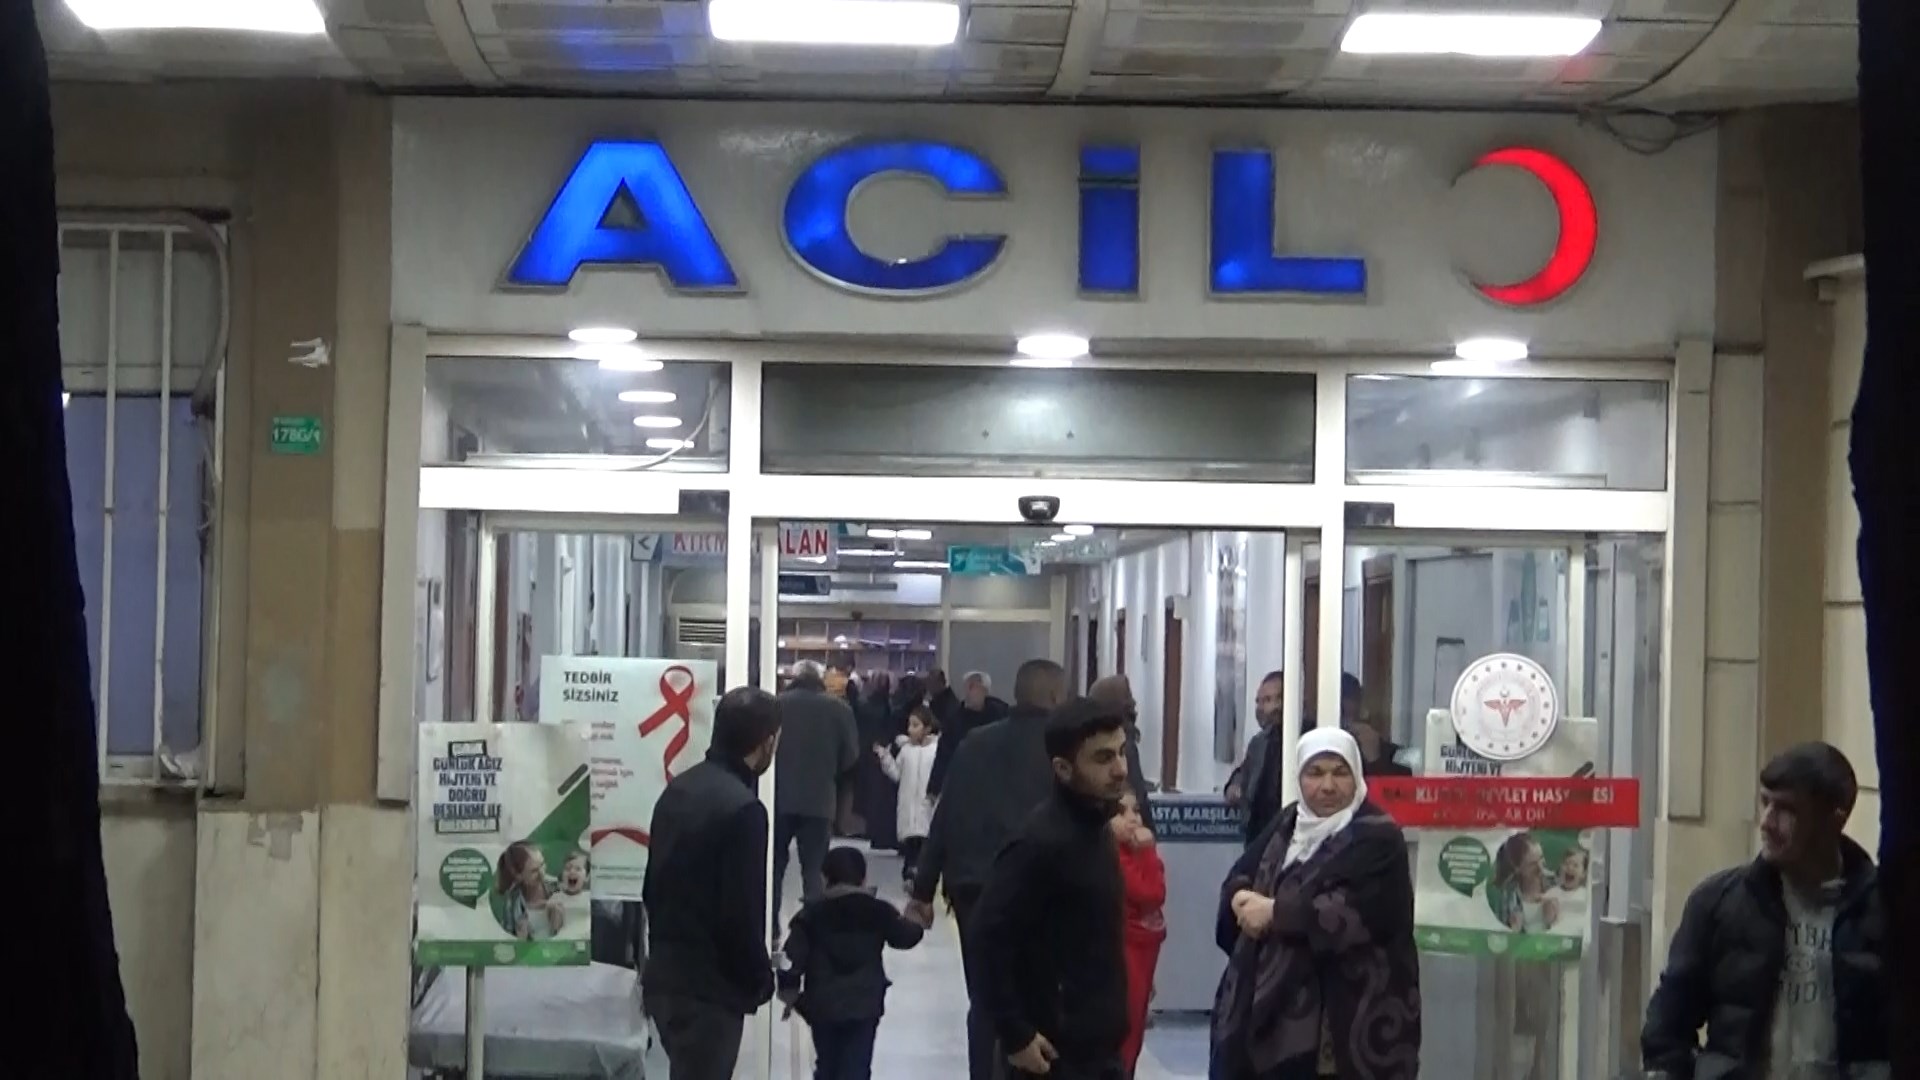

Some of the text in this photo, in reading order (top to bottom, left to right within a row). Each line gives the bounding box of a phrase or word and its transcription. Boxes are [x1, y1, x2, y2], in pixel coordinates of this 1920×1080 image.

[504, 139, 1368, 298] ACİL
[777, 528, 827, 554] LAN
[564, 670, 612, 684] TEDBİR
[563, 688, 619, 702] SİZSİNİZ
[448, 787, 487, 802] DOĞRU
